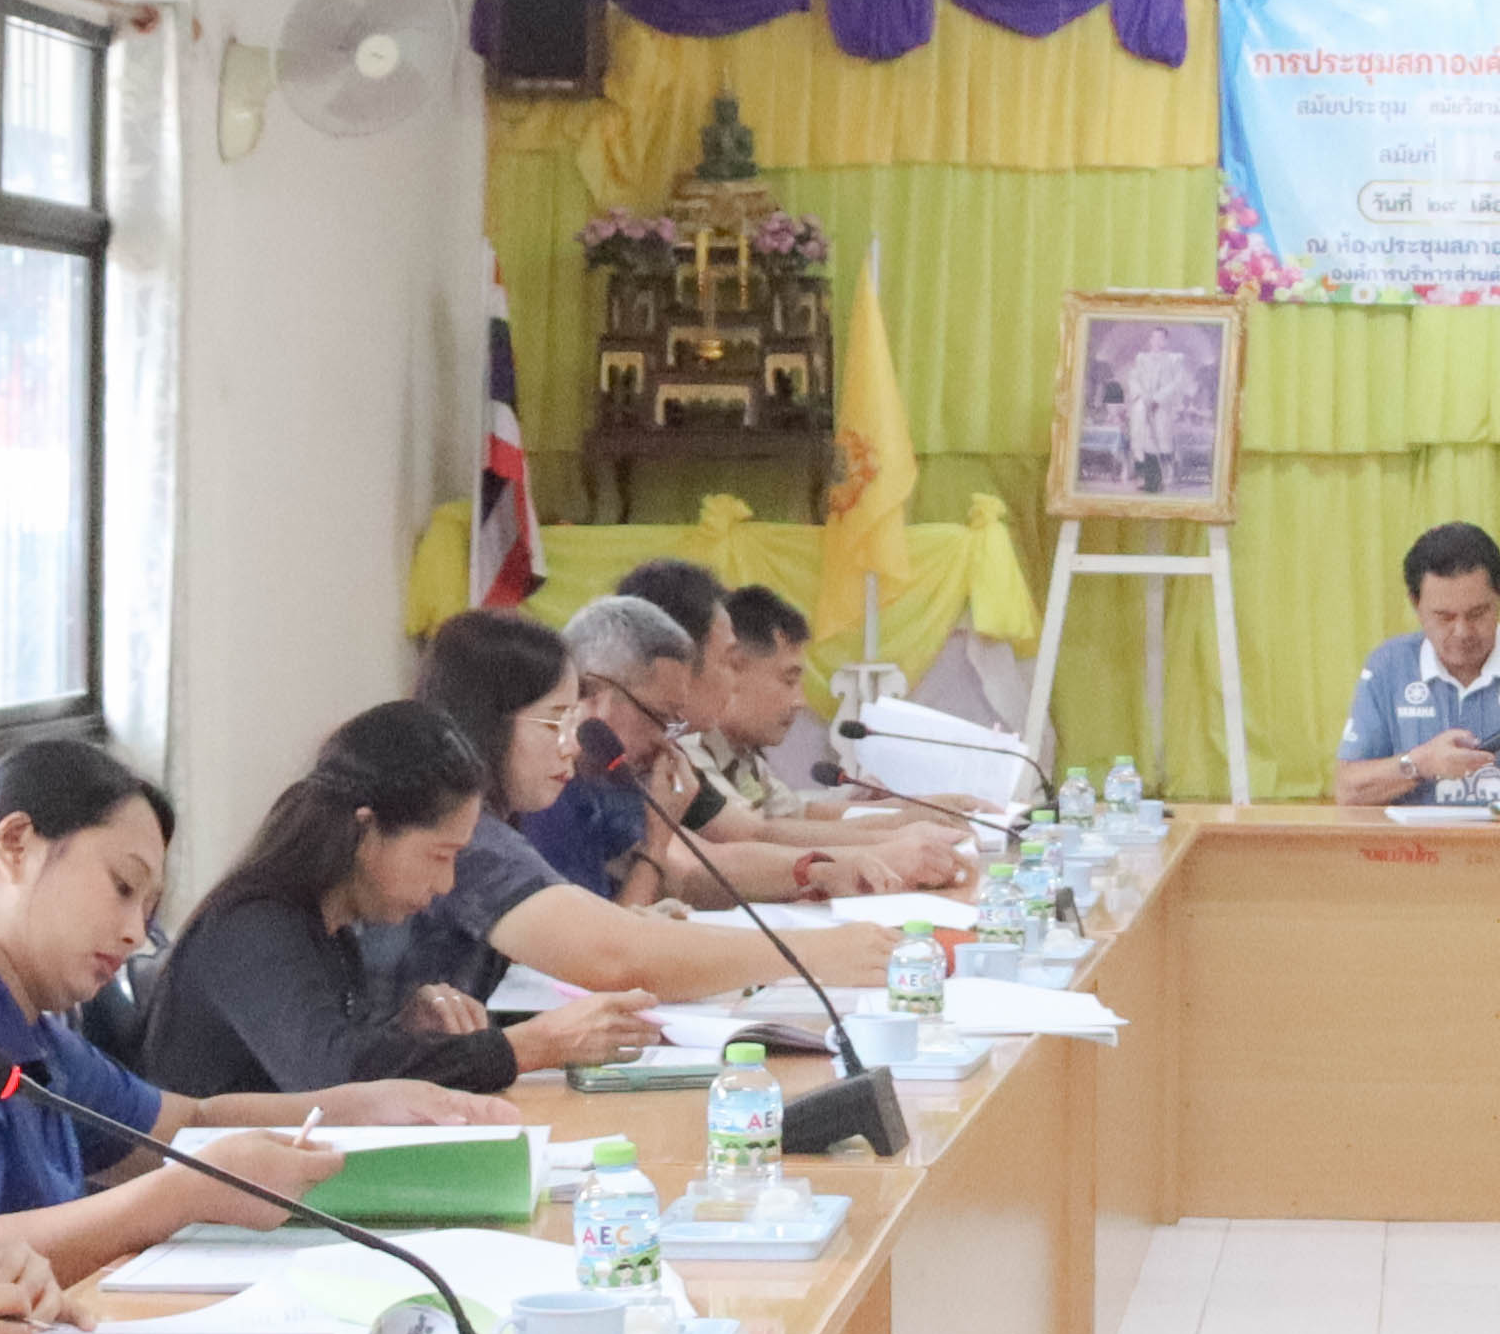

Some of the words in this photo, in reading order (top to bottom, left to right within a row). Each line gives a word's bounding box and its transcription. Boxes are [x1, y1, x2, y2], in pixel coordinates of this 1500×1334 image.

[1297, 93, 1407, 122] สมัยประชุม
[1379, 137, 1437, 164] สมัยที่
[1371, 186, 1413, 213] วันที่
[1306, 237, 1328, 255] ณ
[1397, 705, 1436, 718] YAMAHA
[582, 1225, 632, 1246] AEC
